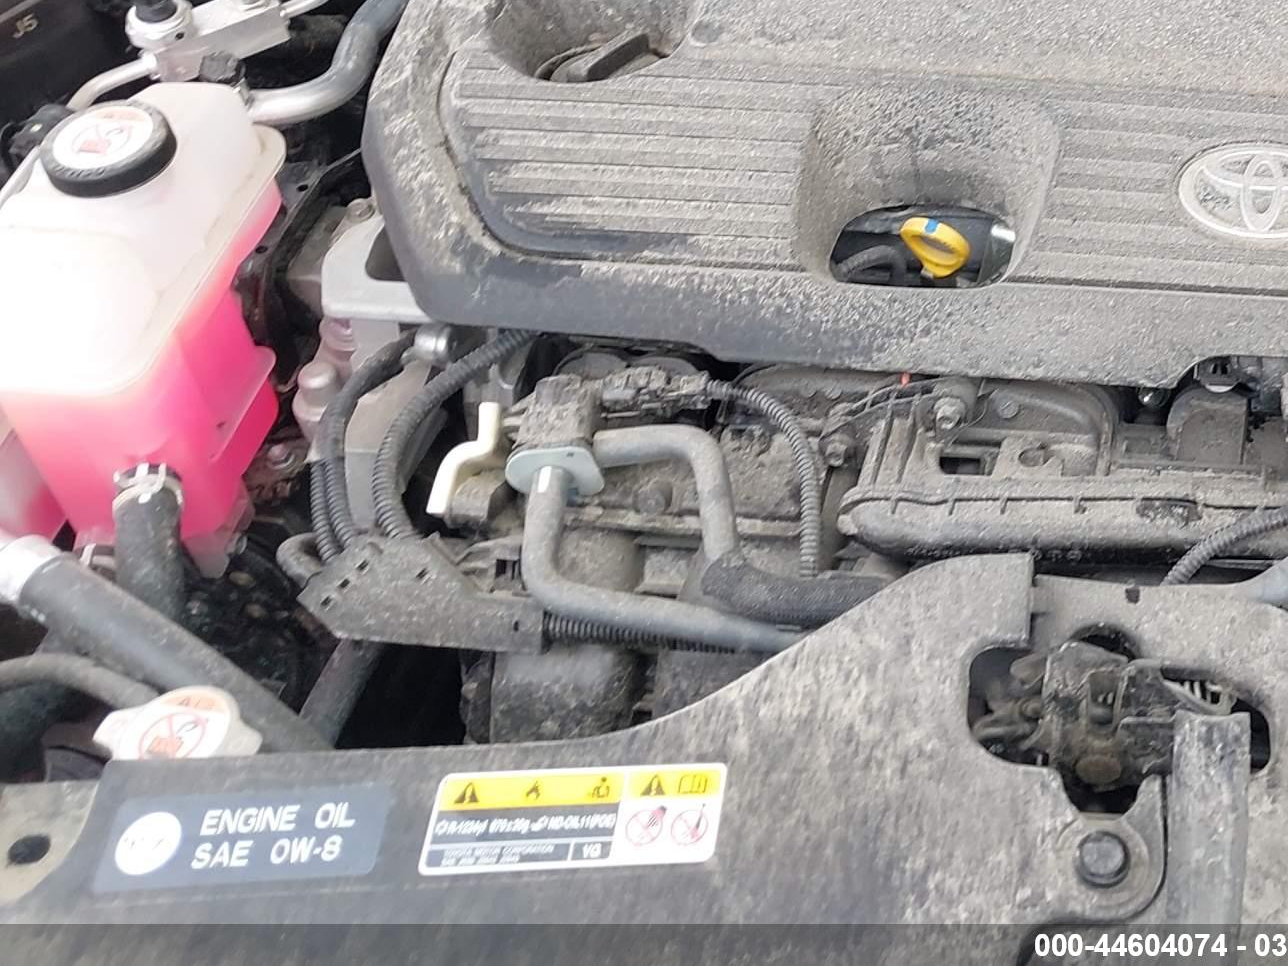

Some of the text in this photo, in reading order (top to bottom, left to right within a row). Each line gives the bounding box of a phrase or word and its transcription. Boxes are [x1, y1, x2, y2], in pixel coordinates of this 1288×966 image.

[200, 802, 355, 836] ENGINE OIL
[191, 840, 253, 869] SAE
